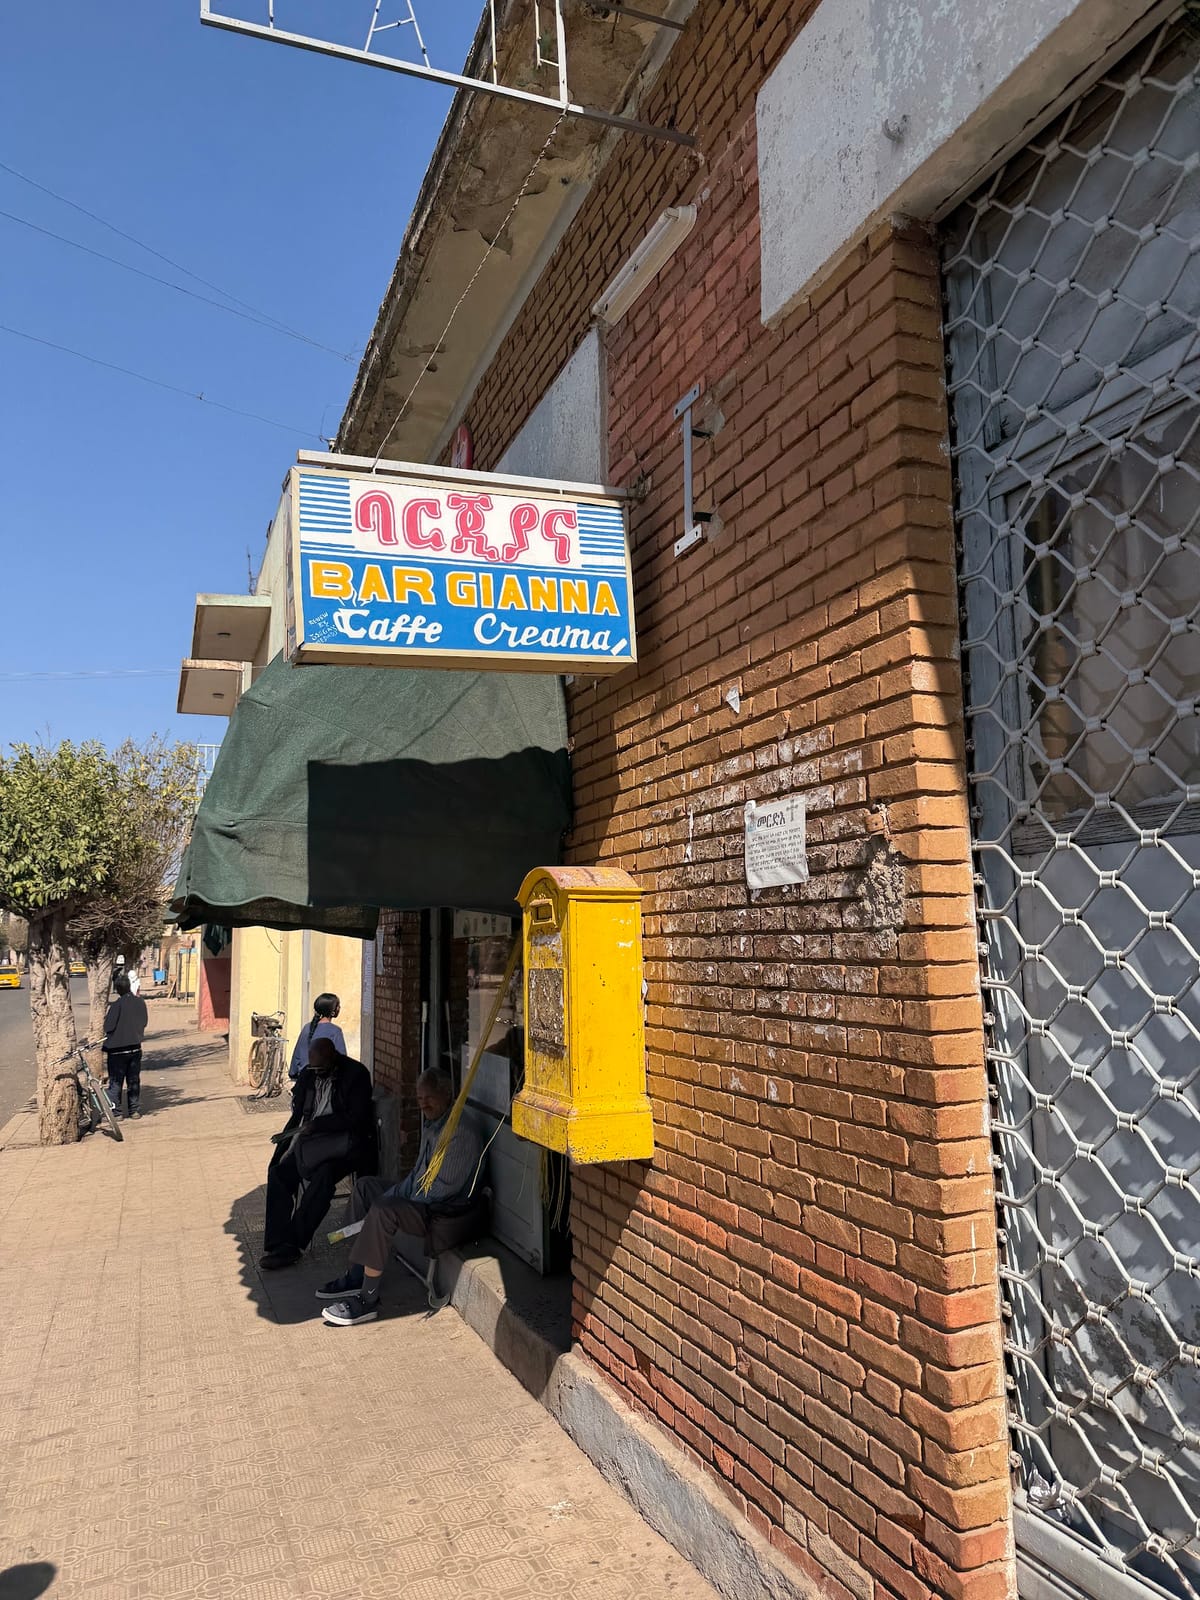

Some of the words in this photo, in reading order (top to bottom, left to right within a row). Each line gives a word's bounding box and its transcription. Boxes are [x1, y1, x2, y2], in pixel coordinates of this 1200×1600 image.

[309, 559, 436, 605] BAR
[445, 571, 620, 617] GIANNA
[333, 607, 443, 646] Caffe
